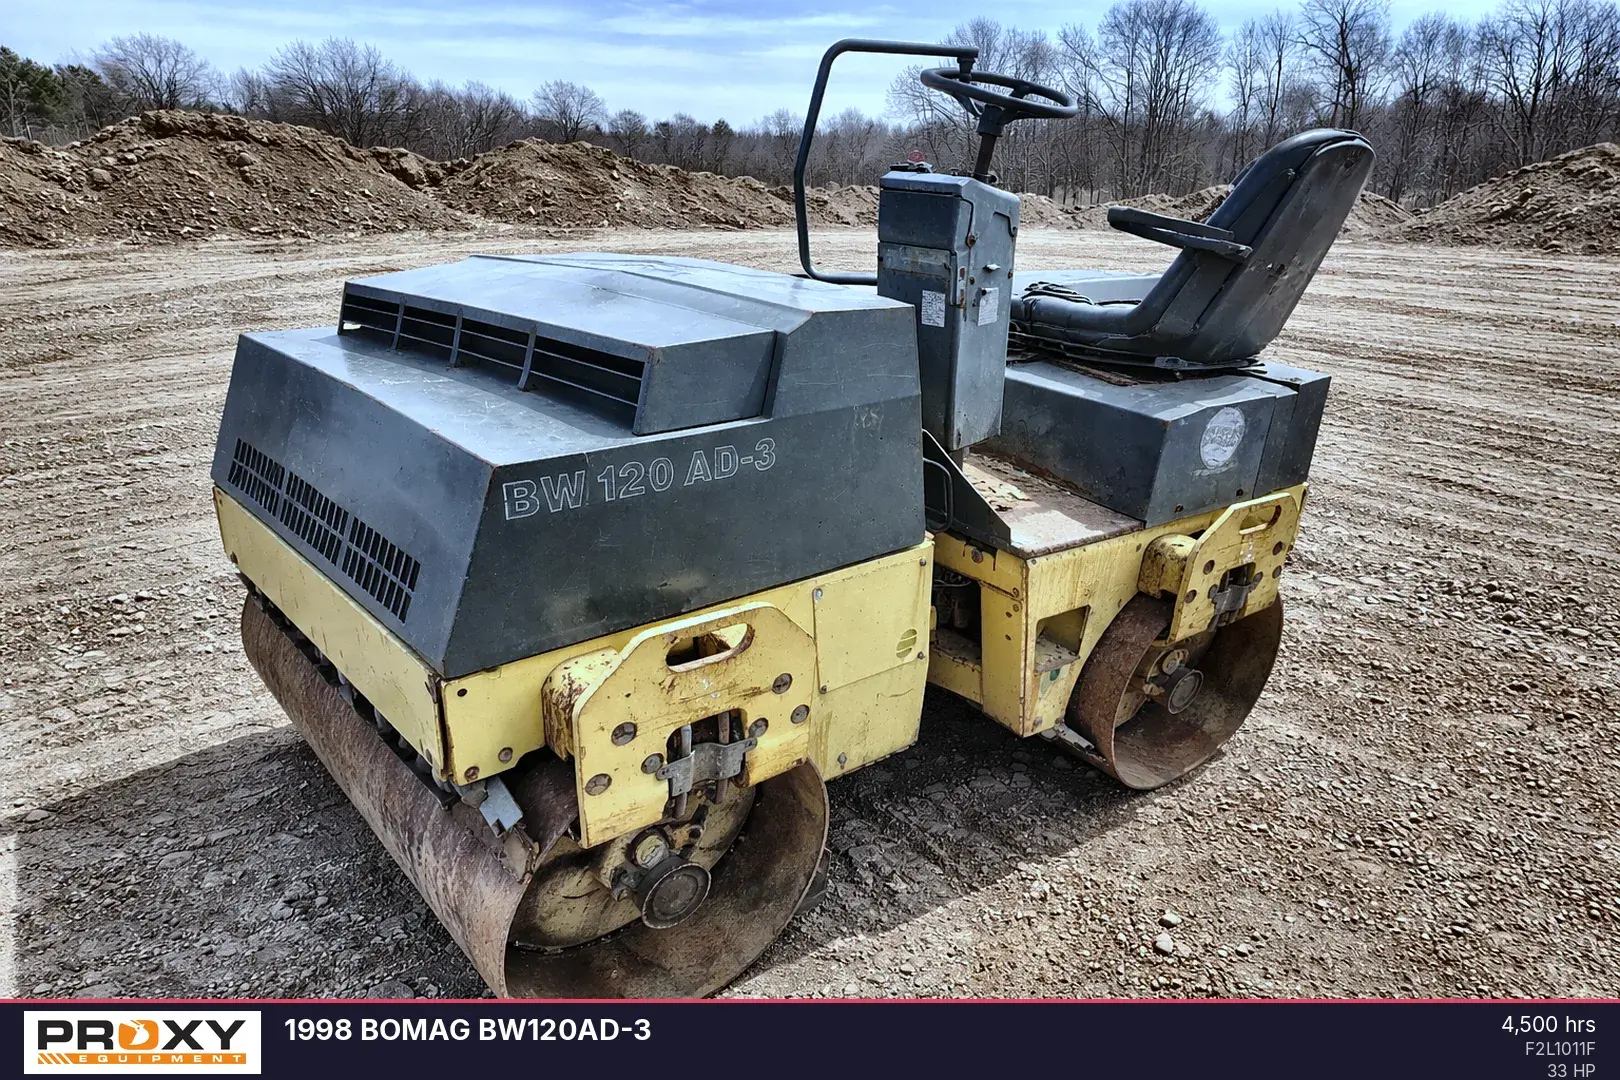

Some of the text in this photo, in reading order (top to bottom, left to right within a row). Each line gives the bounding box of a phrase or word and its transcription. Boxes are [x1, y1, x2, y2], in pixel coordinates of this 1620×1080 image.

[502, 437, 777, 521] BW 120 AD-3
